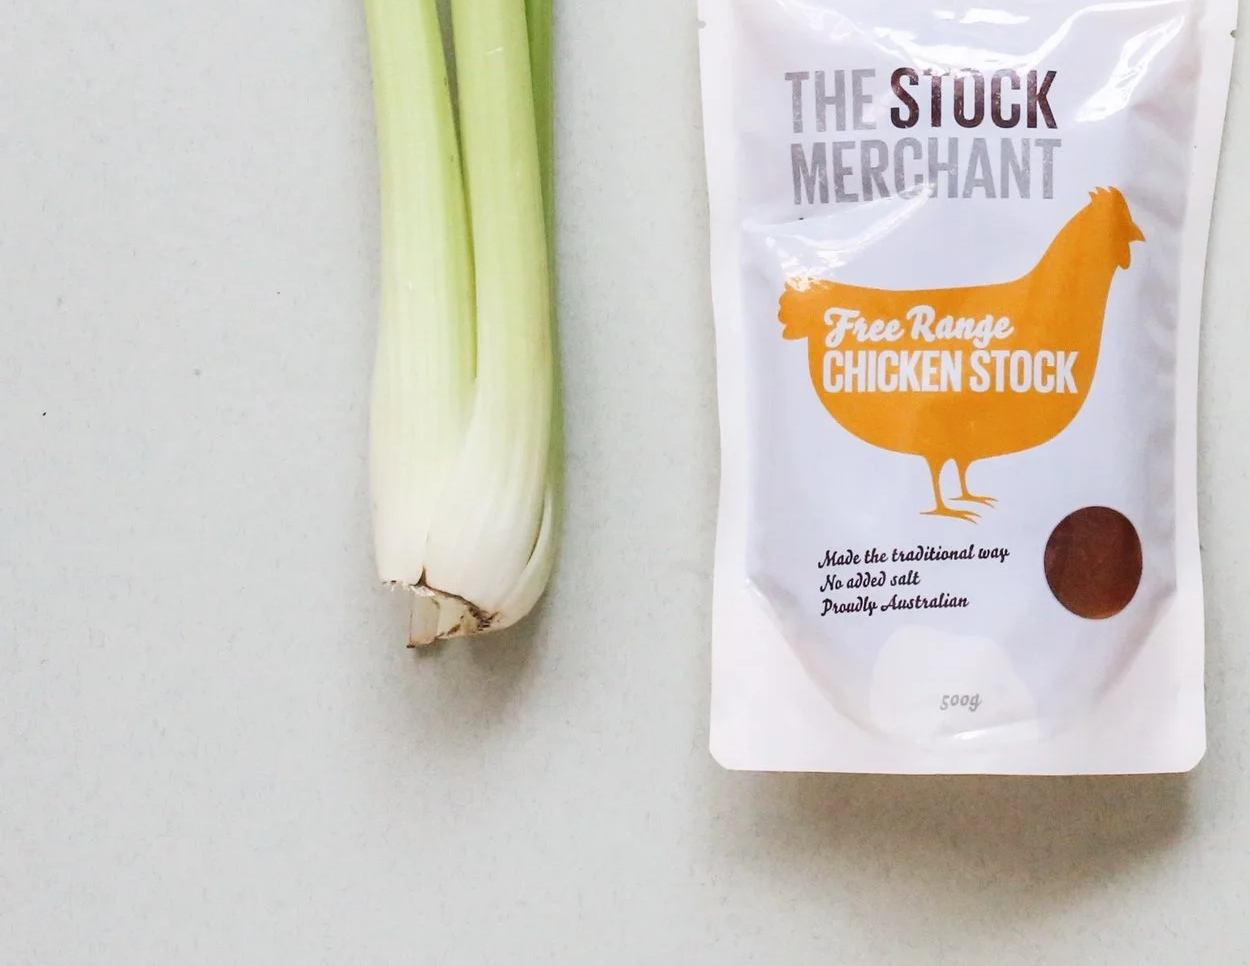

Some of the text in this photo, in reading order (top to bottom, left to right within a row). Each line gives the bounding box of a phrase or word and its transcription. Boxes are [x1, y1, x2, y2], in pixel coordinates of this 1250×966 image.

[784, 67, 1058, 133] THE STOCK
[790, 136, 1062, 205] MERCHANT
[823, 304, 1014, 349] Free Range
[823, 349, 1079, 394] CHICKEN STOCK
[818, 544, 1010, 568] Made the traditional way
[820, 570, 921, 592] No added salt
[820, 593, 969, 616] Proudly Australian
[939, 693, 982, 712] 500g
